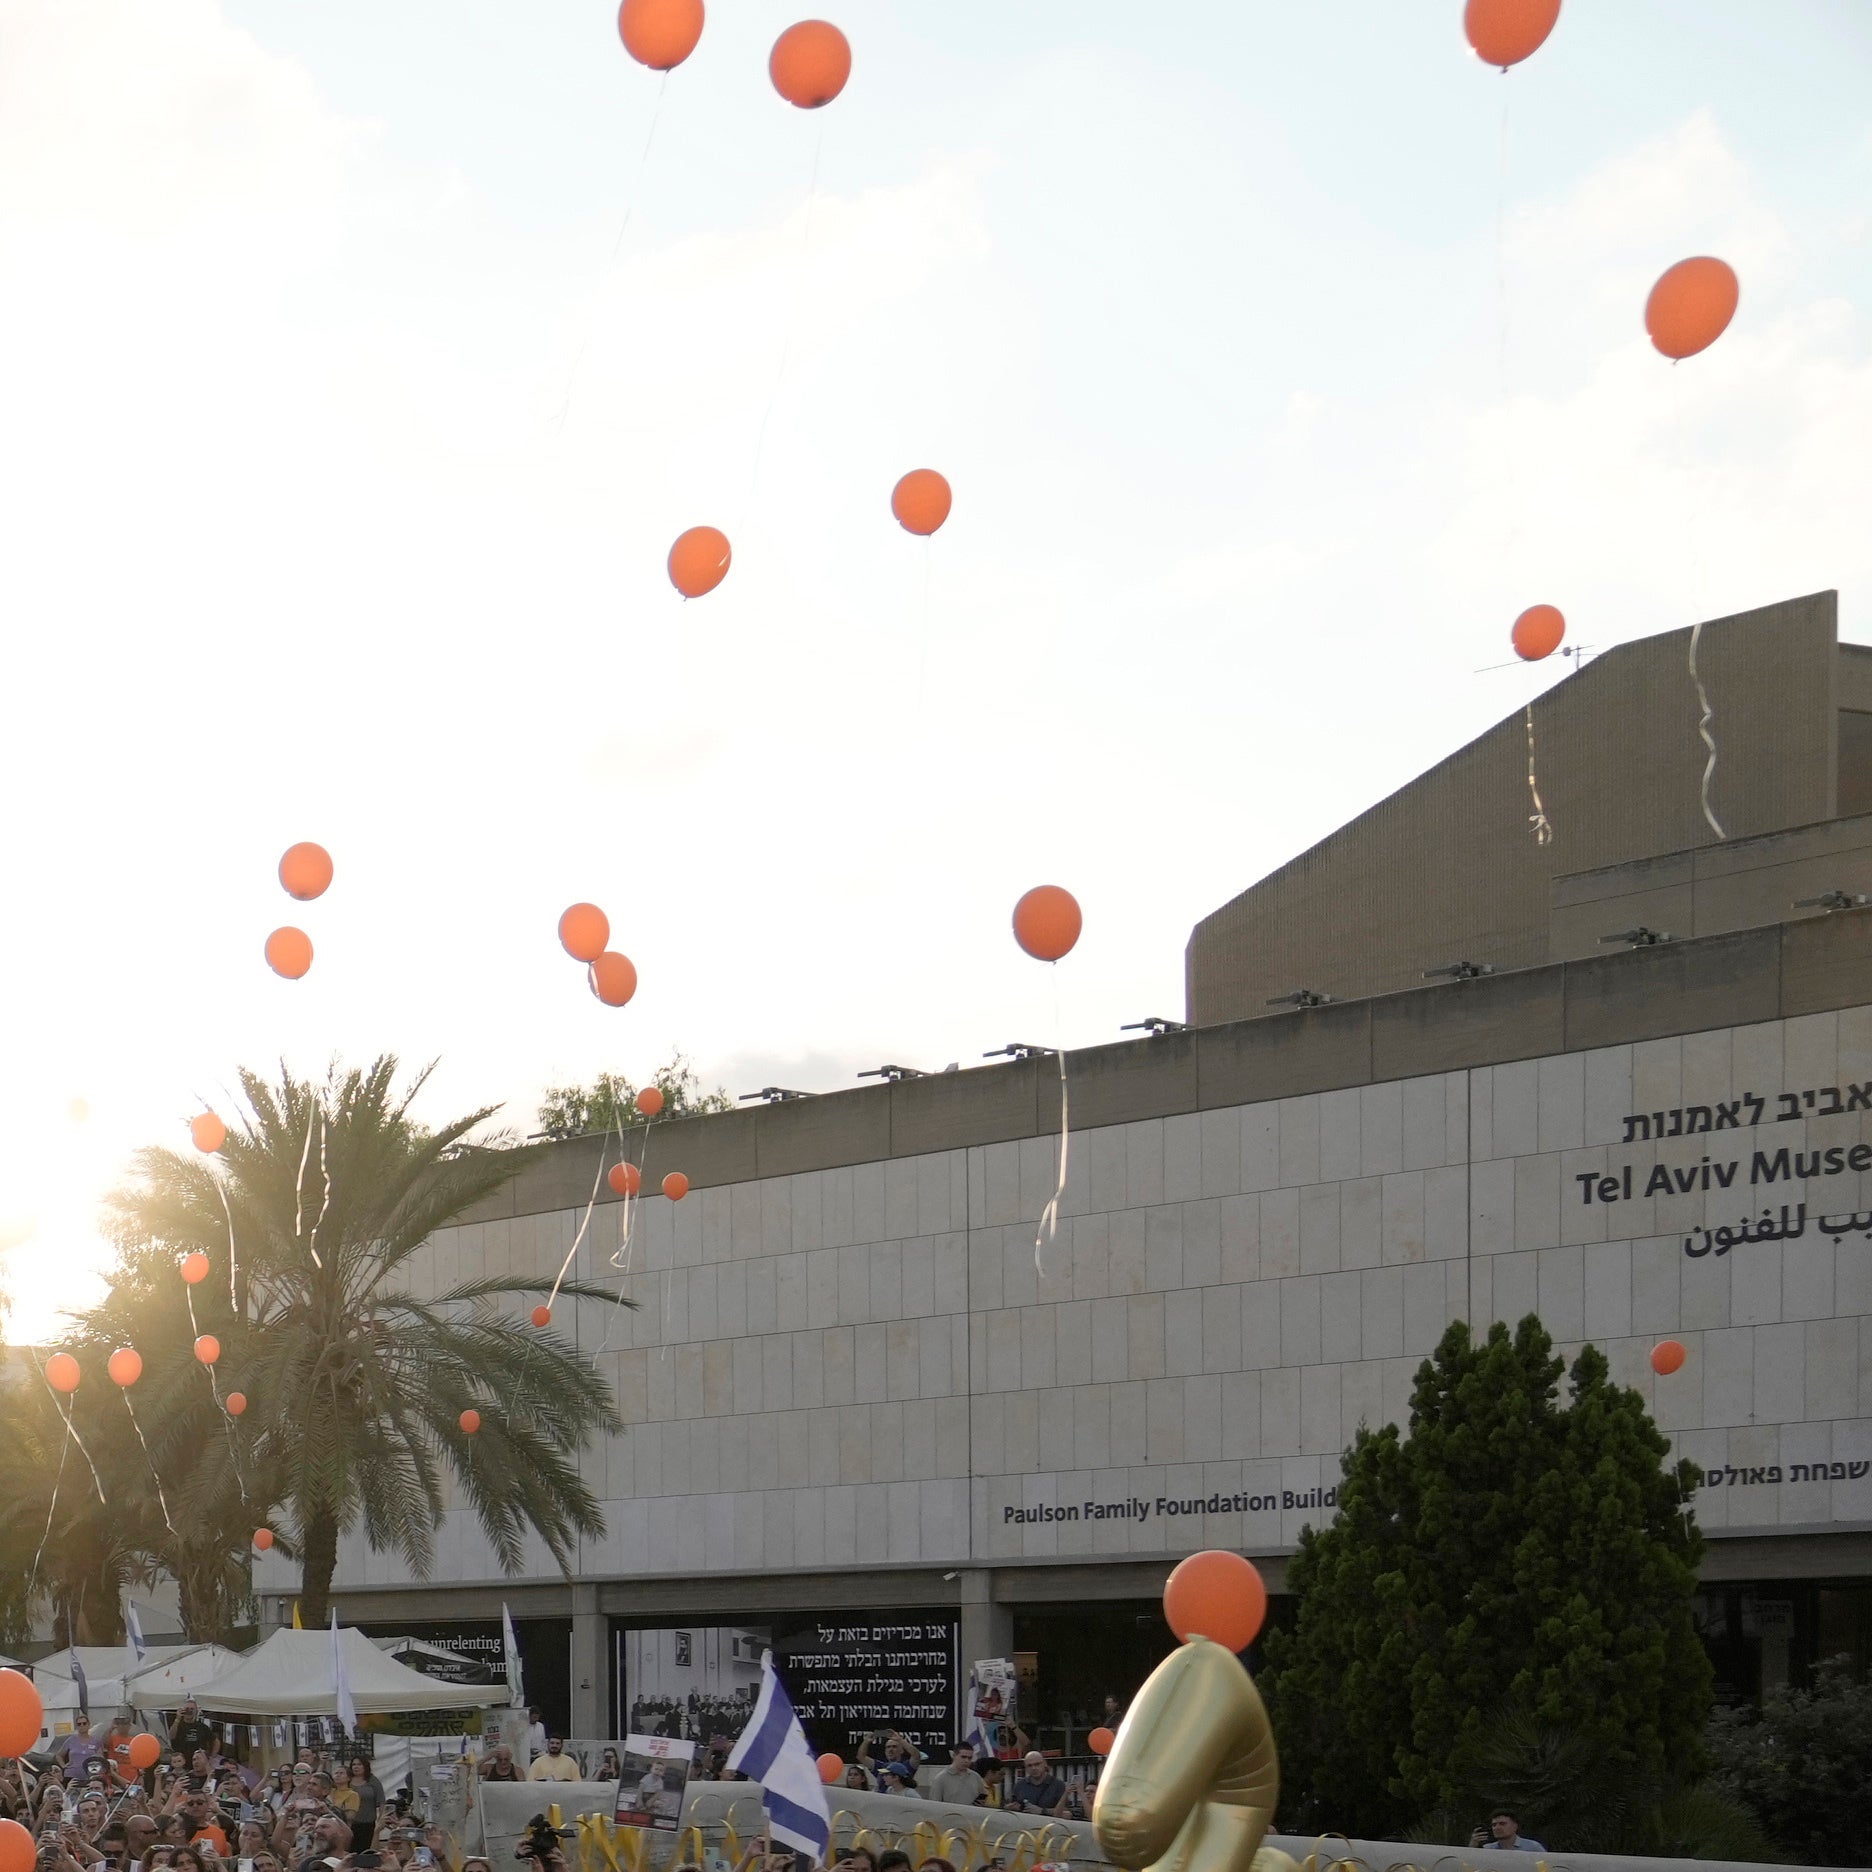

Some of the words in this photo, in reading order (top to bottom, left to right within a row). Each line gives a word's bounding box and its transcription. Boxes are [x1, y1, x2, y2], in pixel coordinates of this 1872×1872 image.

[1623, 1092, 1764, 1143] לאמנות
[1576, 1166, 1632, 1204] Tel
[1644, 1157, 1739, 1197] Aviv
[1684, 1203, 1806, 1258] للفنون
[1004, 1504, 1078, 1524] Paulson
[1084, 1497, 1150, 1522] Family
[1155, 1490, 1276, 1517] Foundation
[817, 1622, 835, 1644] על
[839, 1626, 868, 1642] בזאת
[873, 1625, 922, 1641] מכריזים
[926, 1624, 947, 1640] אנו
[788, 1654, 840, 1670] מתפשרת
[844, 1647, 882, 1668] הבלתי
[885, 1651, 947, 1668] מחויבותנו
[803, 1677, 862, 1695] העצמאות,
[866, 1673, 904, 1694] מגילת
[907, 1672, 947, 1695] לערכי
[818, 1700, 836, 1719] תל
[839, 1704, 889, 1724] במוזיאון
[893, 1703, 947, 1720] שנחתמה
